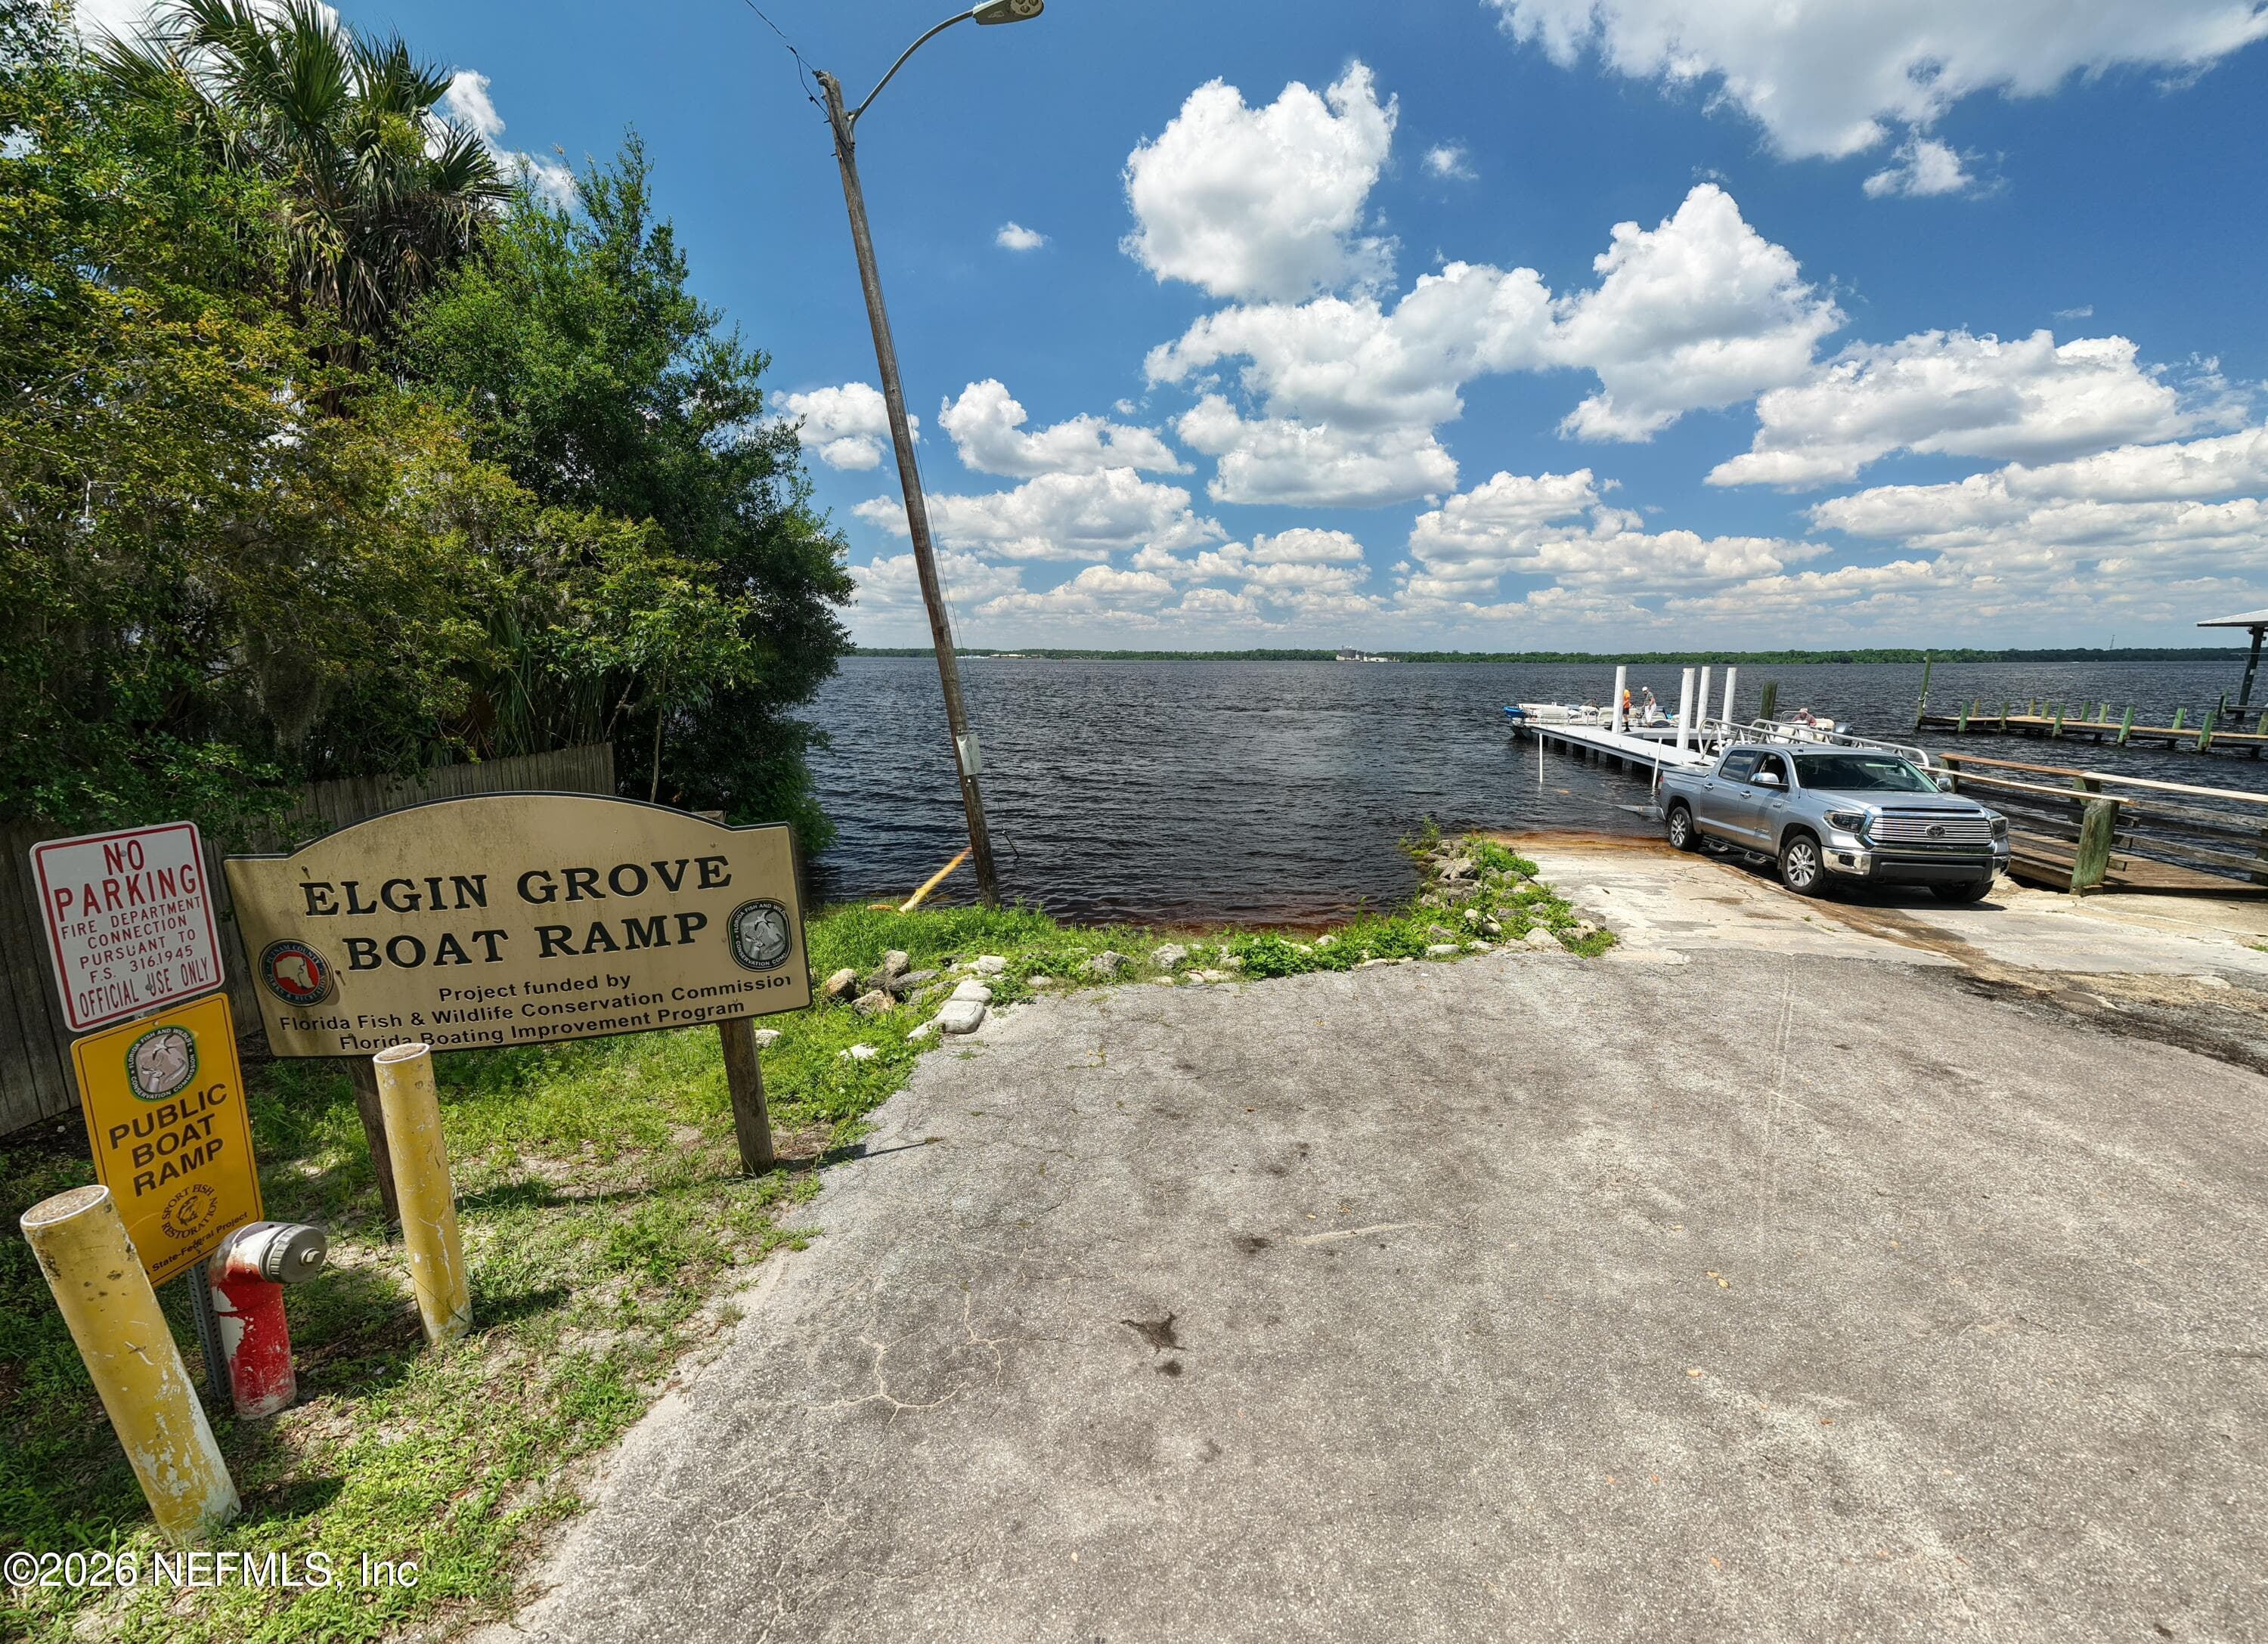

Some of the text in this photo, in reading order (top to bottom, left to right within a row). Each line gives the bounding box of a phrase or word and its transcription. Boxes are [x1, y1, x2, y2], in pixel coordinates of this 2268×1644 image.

[103, 840, 145, 875] NO
[54, 864, 197, 922] PARKING
[299, 855, 732, 917] ELGIN GROVE
[61, 896, 201, 940] FIRE DEPARTMENT
[88, 915, 187, 949] CONNECTION
[734, 912, 745, 933] FLORIDA
[745, 904, 758, 912] FISH
[80, 929, 196, 969] PURSUANT TO
[293, 945, 319, 964] COUNTY
[342, 912, 708, 971] BOAT RAMP
[736, 941, 770, 966] CONSERVATION
[90, 946, 194, 984] F.S. 316.1945
[79, 956, 209, 1018] OFFICIAL USE ONLY
[439, 974, 631, 1003] Project funded by
[280, 1017, 351, 1031] Florida
[358, 1014, 402, 1029] Fish
[411, 1012, 425, 1026] &
[432, 1006, 513, 1027] Wildlife
[522, 992, 664, 1017] Conservation
[339, 1002, 745, 1049] Florida Boating Improvement Program
[129, 1043, 141, 1069] FLORIDA
[141, 1033, 155, 1043] FISH
[173, 1029, 193, 1047] WILDLIFE
[131, 1054, 196, 1099] CONSERVATION COMMISSION
[109, 1083, 228, 1150] PUBLIC
[132, 1113, 216, 1169] BOAT
[133, 1138, 225, 1197] RAMP
[162, 1184, 215, 1219] SPORT FISH
[162, 1197, 218, 1239] RESTORATION
[216, 1212, 248, 1235] Project
